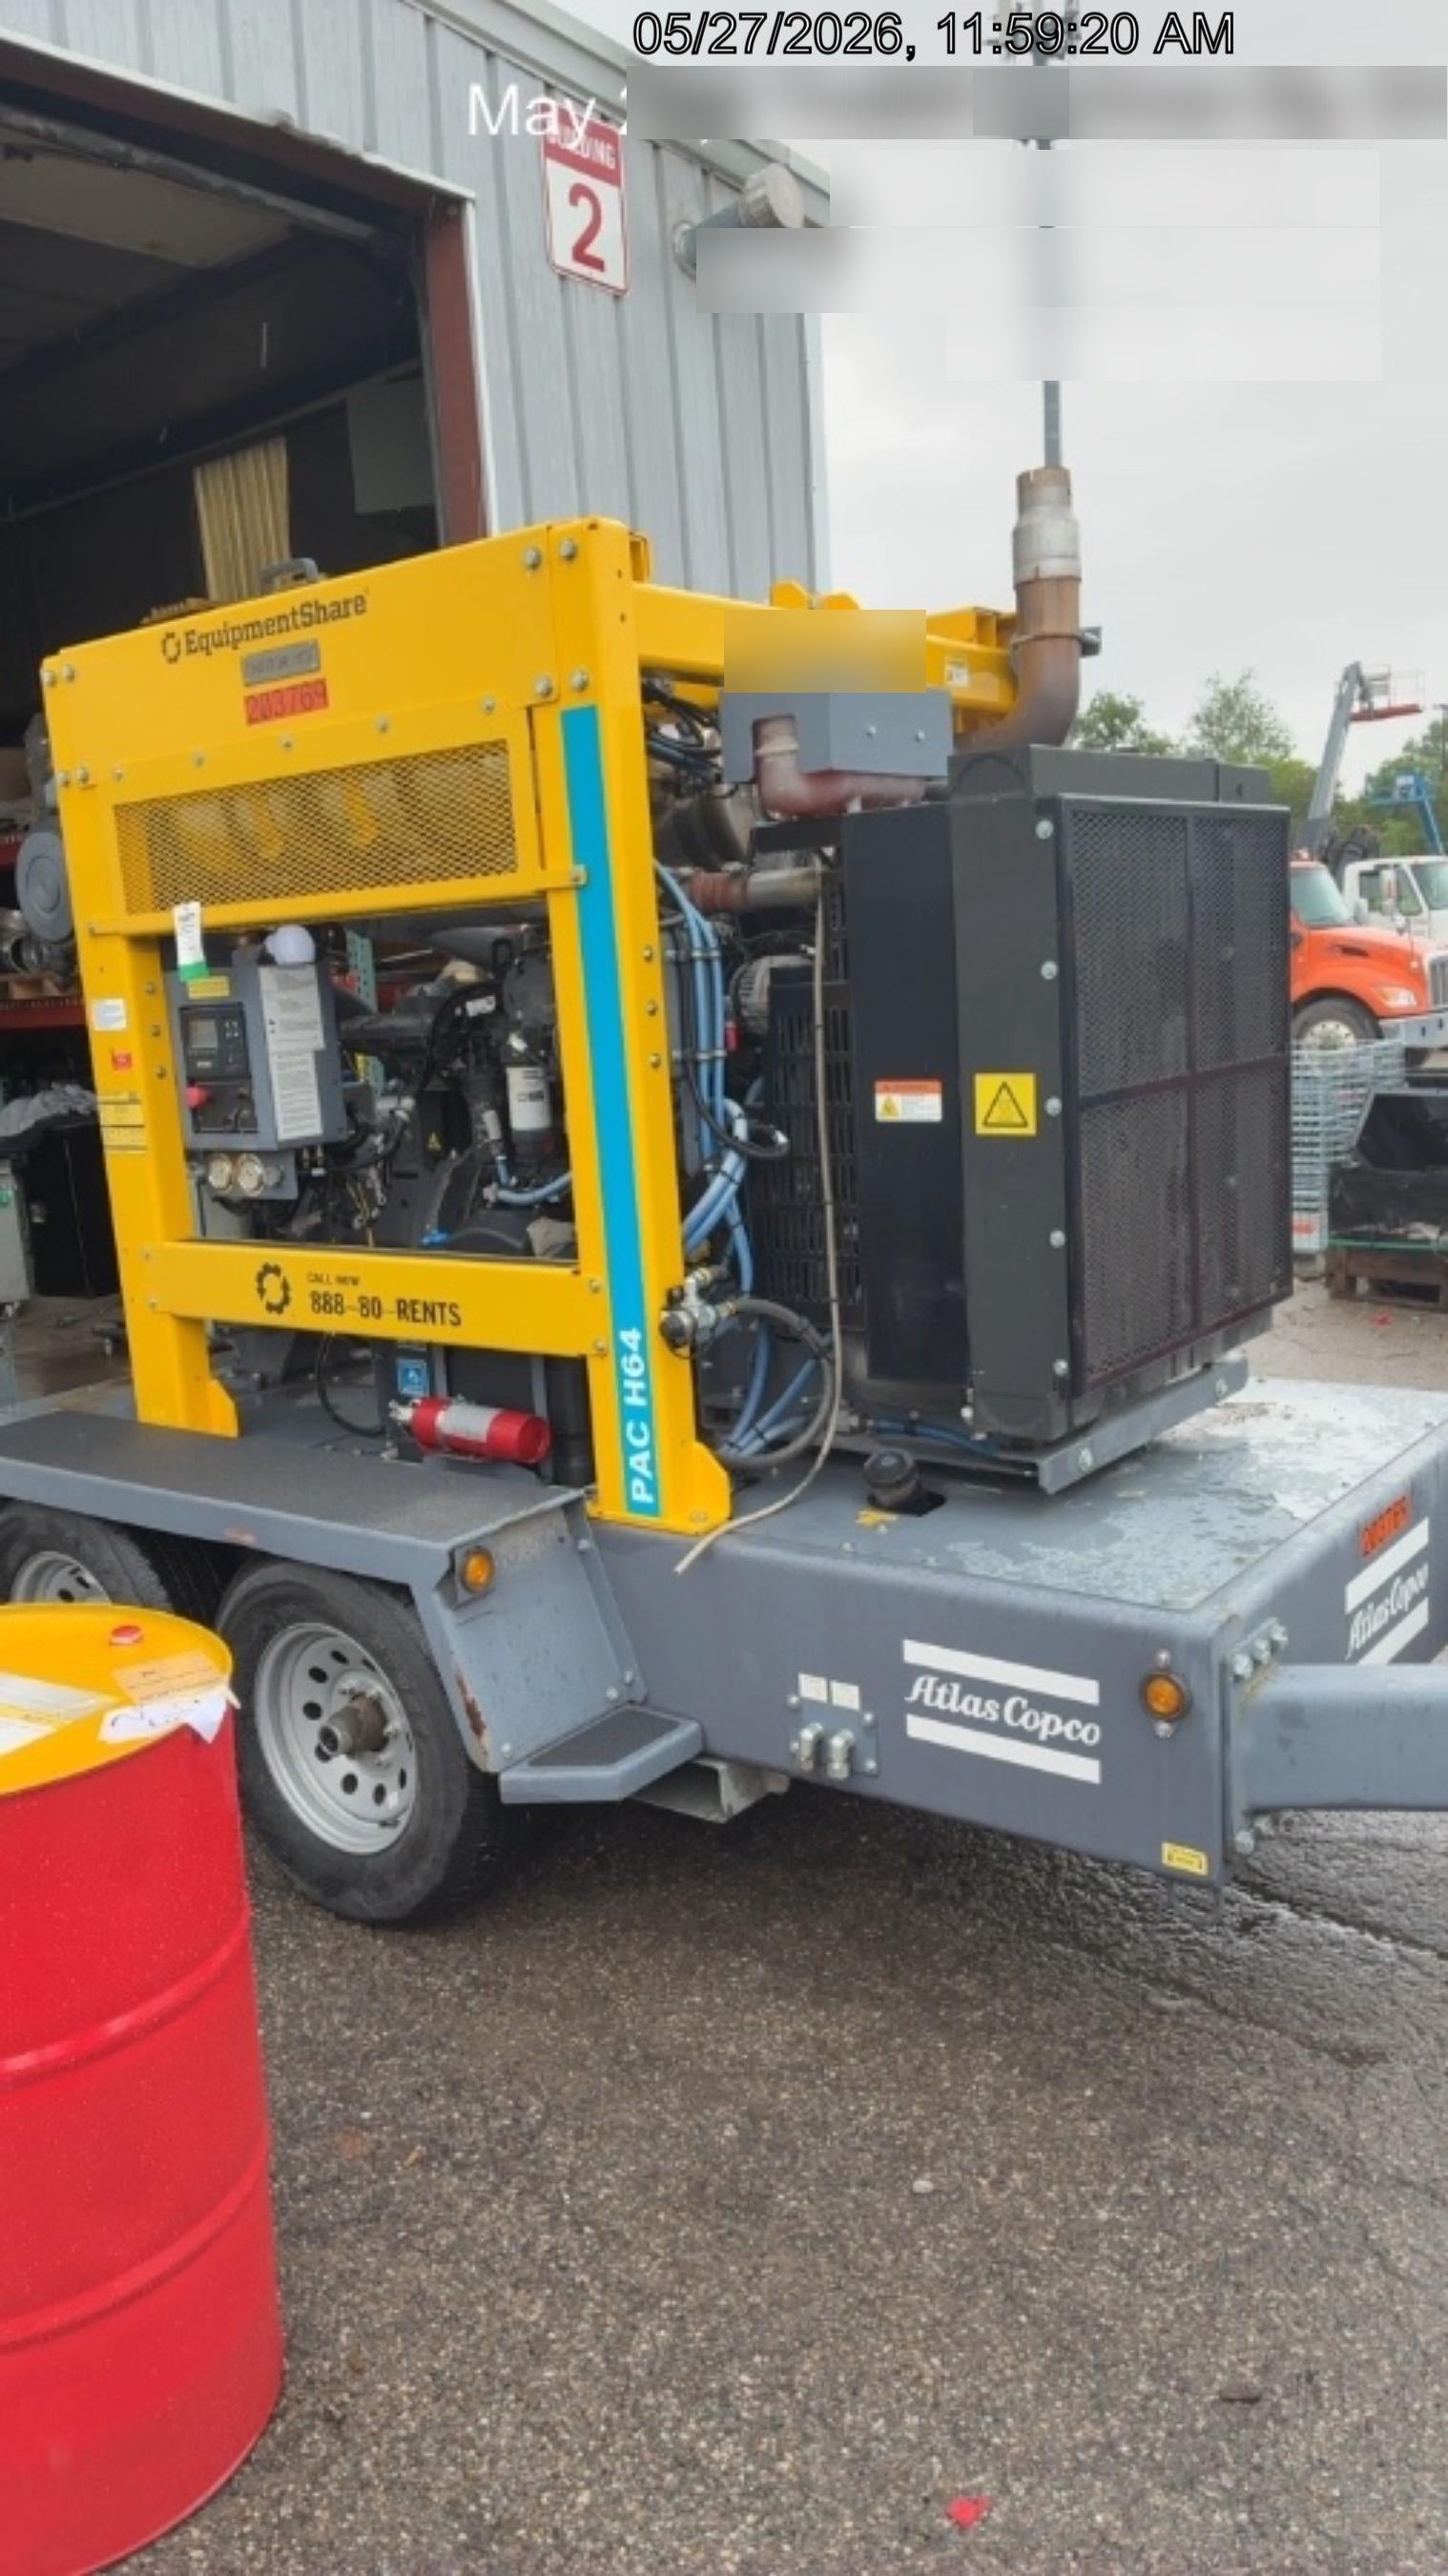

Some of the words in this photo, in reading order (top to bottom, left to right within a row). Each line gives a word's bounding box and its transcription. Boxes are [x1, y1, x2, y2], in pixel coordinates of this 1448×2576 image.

[569, 182, 606, 273] 2
[184, 593, 367, 656] EquipmentShare
[620, 1328, 648, 1406] H64
[626, 1420, 654, 1504] PAC
[904, 1674, 1001, 1722] Atlas
[1003, 1695, 1100, 1746] Copco
